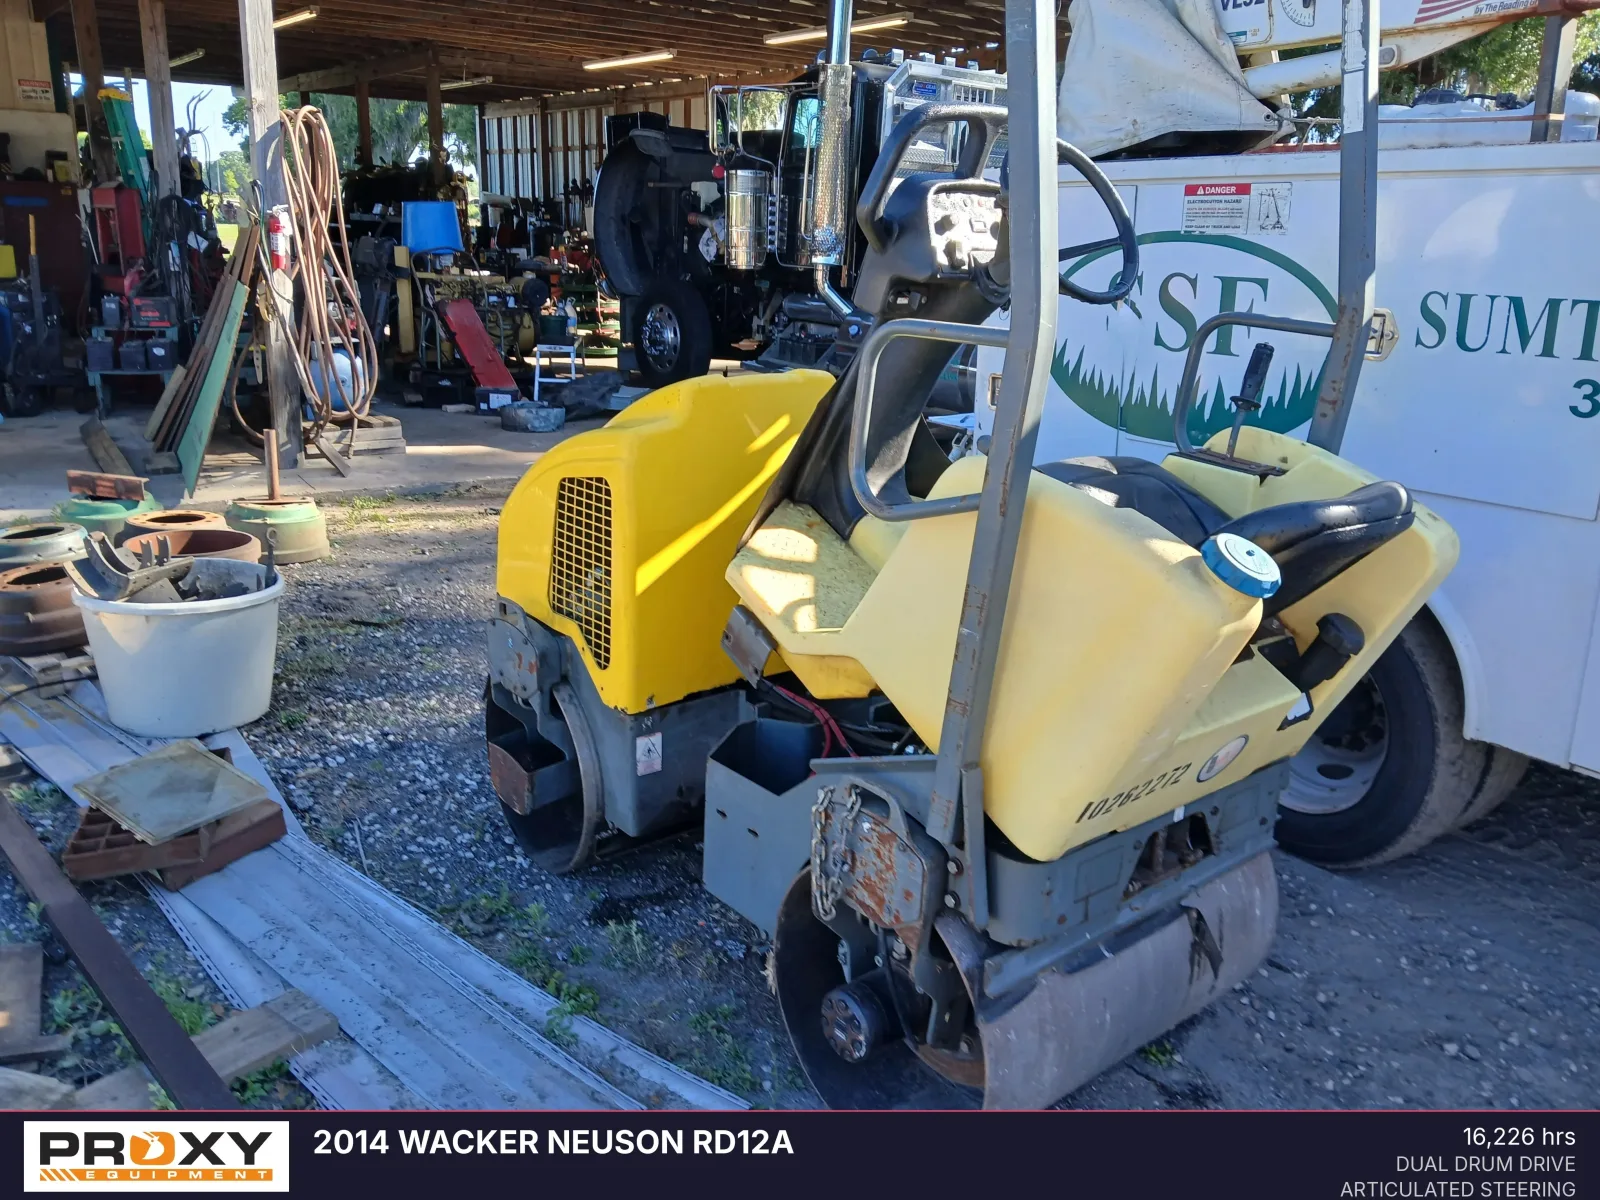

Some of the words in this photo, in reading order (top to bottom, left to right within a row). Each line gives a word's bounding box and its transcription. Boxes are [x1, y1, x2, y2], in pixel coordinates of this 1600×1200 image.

[1485, 3, 1498, 13] The
[1499, 0, 1529, 11] Reading
[1205, 186, 1236, 194] DANGER
[1415, 290, 1600, 362] SUMT
